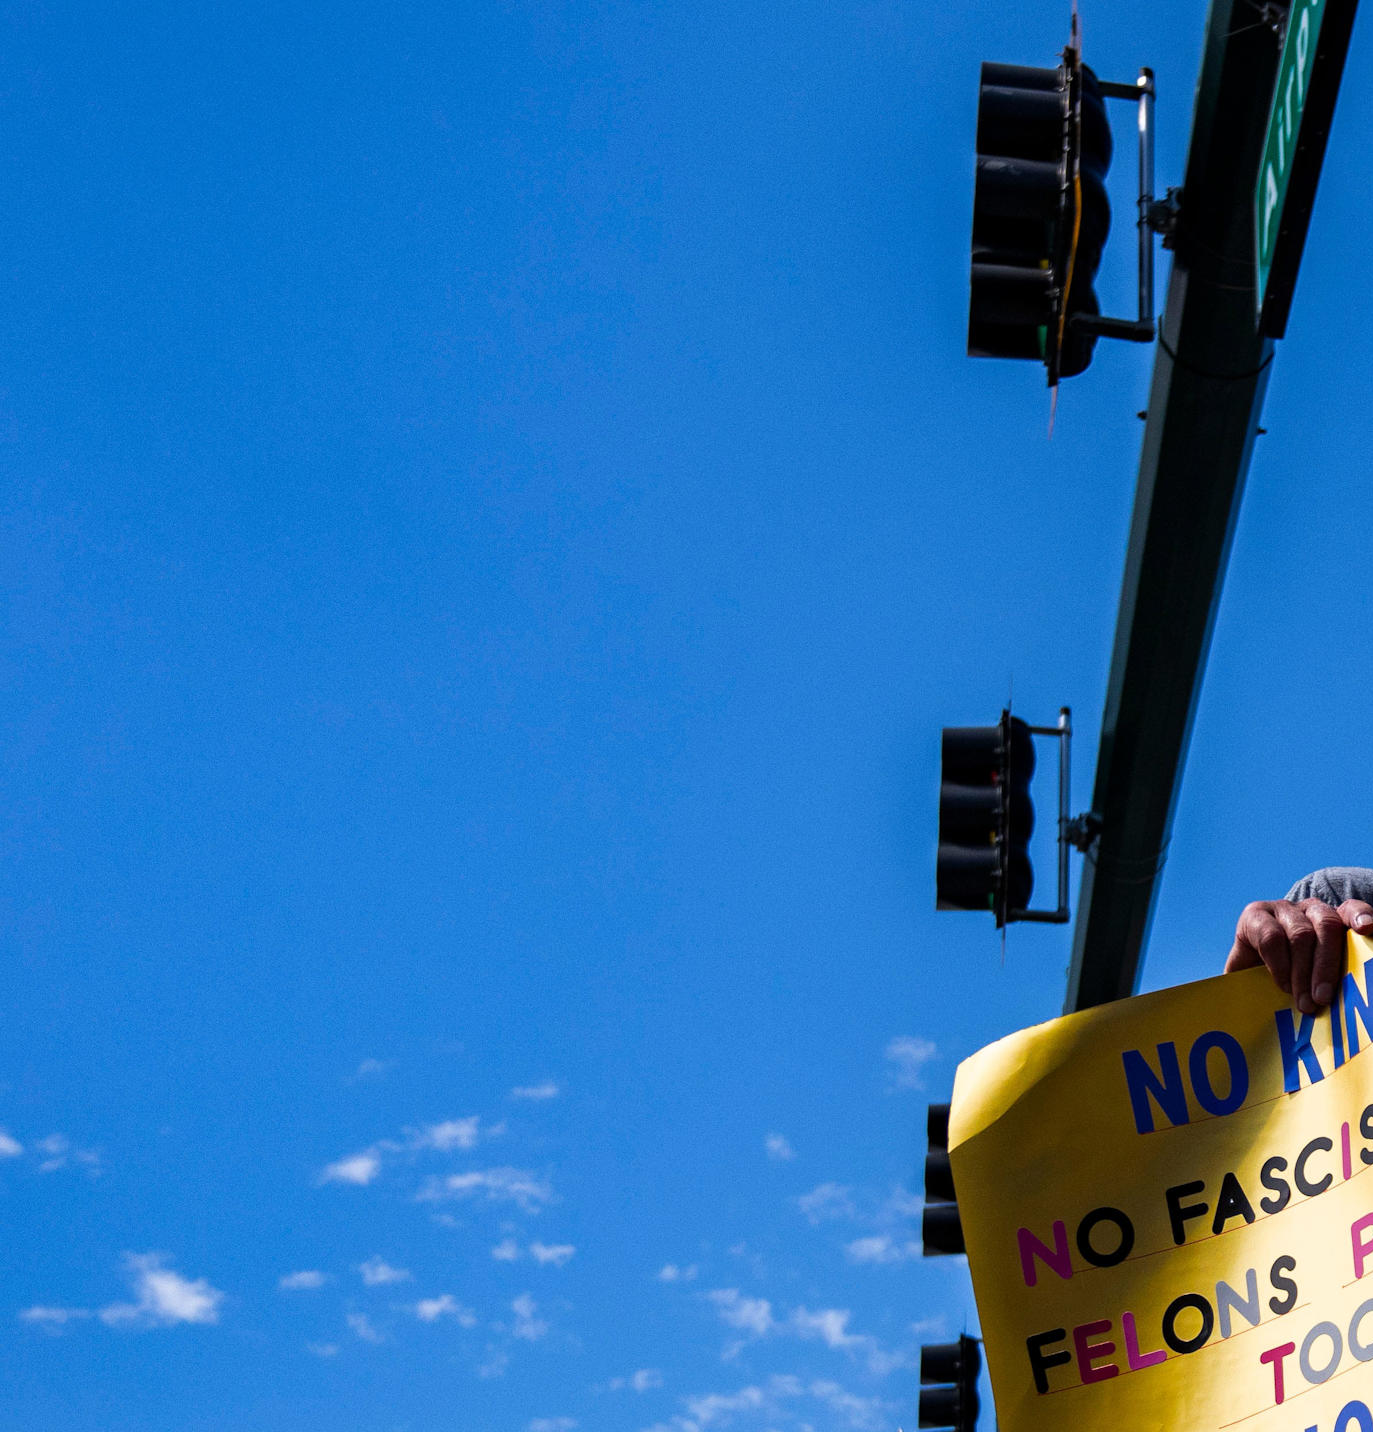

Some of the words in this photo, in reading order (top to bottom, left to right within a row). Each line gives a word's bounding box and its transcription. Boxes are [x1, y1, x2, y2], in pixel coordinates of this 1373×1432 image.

[1263, 0, 1318, 256] Airp
[1122, 1031, 1249, 1134] NO
[1017, 1207, 1136, 1288] NO
[1026, 1255, 1299, 1395] FELONS
